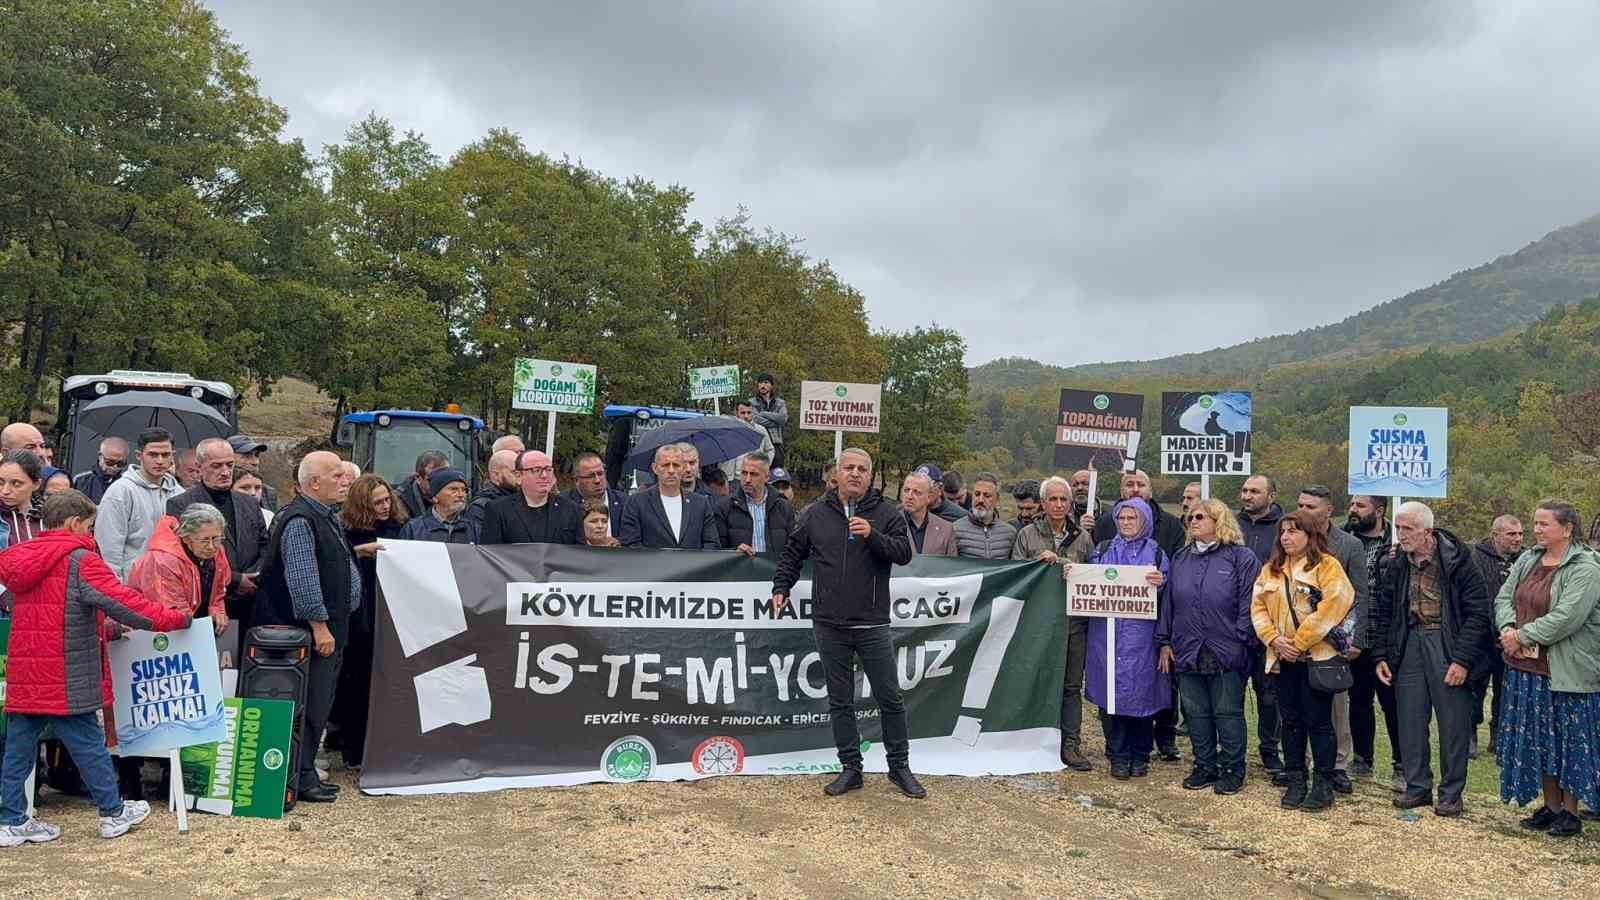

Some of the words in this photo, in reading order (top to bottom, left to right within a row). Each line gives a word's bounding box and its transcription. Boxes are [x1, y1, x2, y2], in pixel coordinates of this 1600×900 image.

[534, 378, 577, 393] DOĞAMI
[520, 390, 588, 407] KORUYORUM
[808, 400, 828, 411] TOZ
[831, 401, 874, 413] YUTMAK
[804, 411, 877, 427] İSTEMİYORUZ!
[1062, 411, 1137, 430] TOPRAĞIMA
[1167, 437, 1224, 450] MADENE
[1370, 429, 1426, 444] SUSMA
[1371, 444, 1425, 461] SUSUZ
[1366, 461, 1429, 480] KALMA!
[1075, 584, 1097, 596] TOZ
[1100, 584, 1150, 598] YUTMAK
[520, 587, 744, 620] KÖYLERİMİZDE
[1071, 596, 1154, 613] İSTEMİYORUZ!
[131, 652, 194, 682] SUSMA
[136, 674, 195, 703] SUSUZ
[133, 697, 206, 729] KALMA!
[584, 711, 641, 725] FEVZİYE
[652, 712, 709, 726] ŞÜKRİYE
[721, 714, 781, 726] FINDICAK
[235, 707, 261, 807] ORMANIMA
